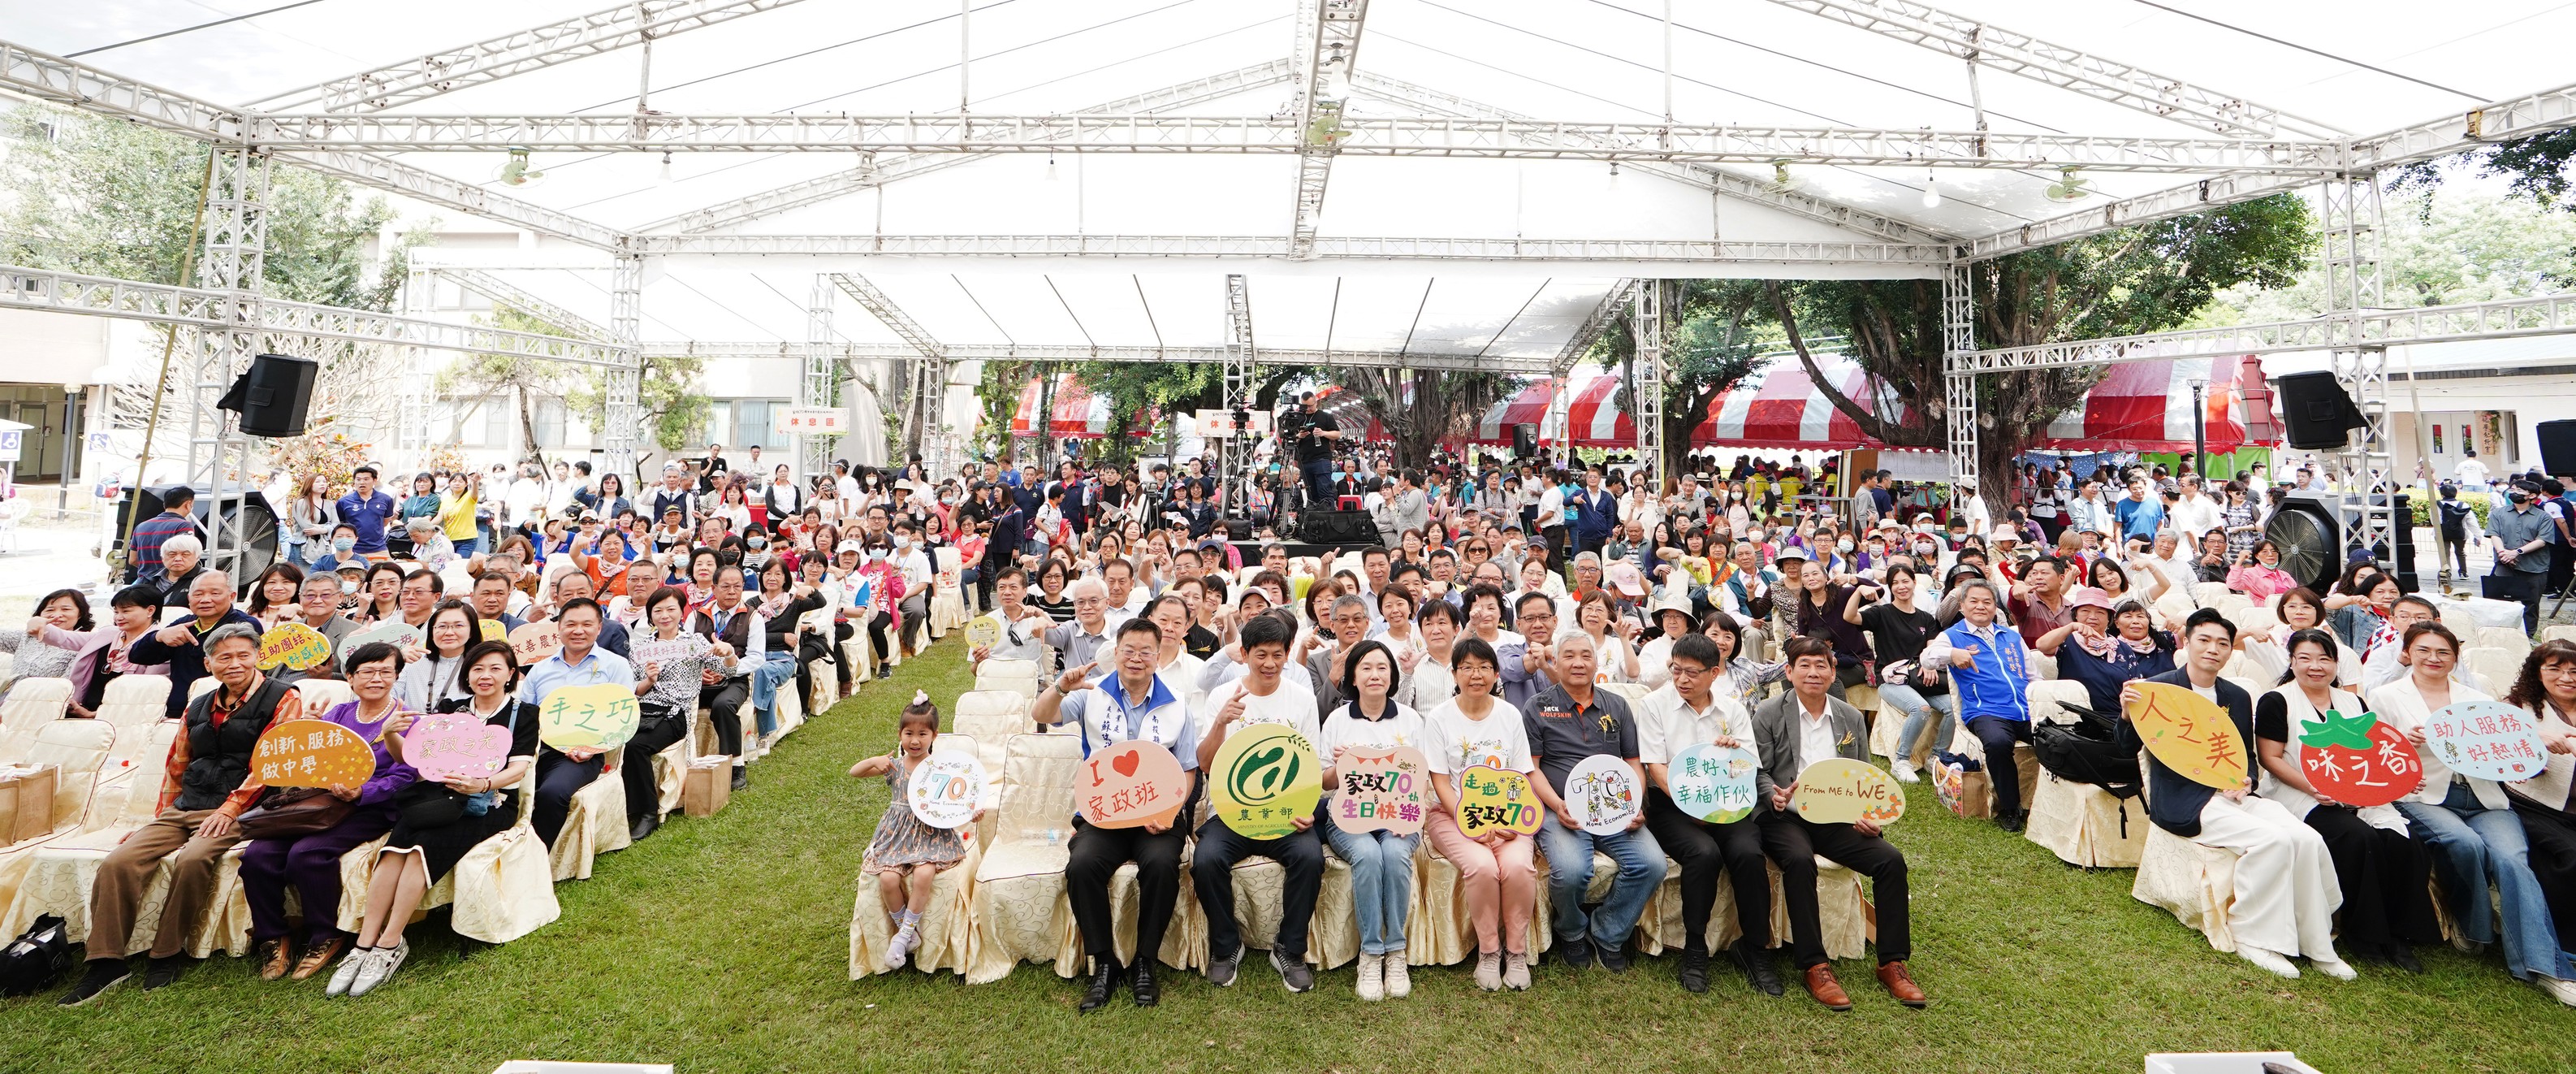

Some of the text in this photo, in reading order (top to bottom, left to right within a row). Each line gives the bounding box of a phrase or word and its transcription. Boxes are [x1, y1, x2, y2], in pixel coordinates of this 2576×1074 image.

[791, 418, 834, 427] 休息區
[287, 641, 326, 665] 好感情
[547, 697, 636, 731] 手之巧
[2140, 691, 2241, 770] 人之美
[419, 730, 498, 760] 家政之光
[2467, 738, 2535, 762] 好熱情
[261, 755, 318, 781] 做中學
[1090, 760, 1104, 787] I
[2306, 740, 2409, 786] 味之香
[931, 773, 967, 801] 70
[1463, 773, 1500, 796] 走過
[1677, 784, 1751, 805] 幸福作伙
[1803, 779, 1886, 800] From ME to WE
[1088, 781, 1159, 822] 家政班
[1238, 807, 1294, 821] 農業部
[1342, 799, 1420, 822] 生日快樂
[1463, 803, 1537, 829] 家政70
[1604, 810, 1636, 825] Economics
